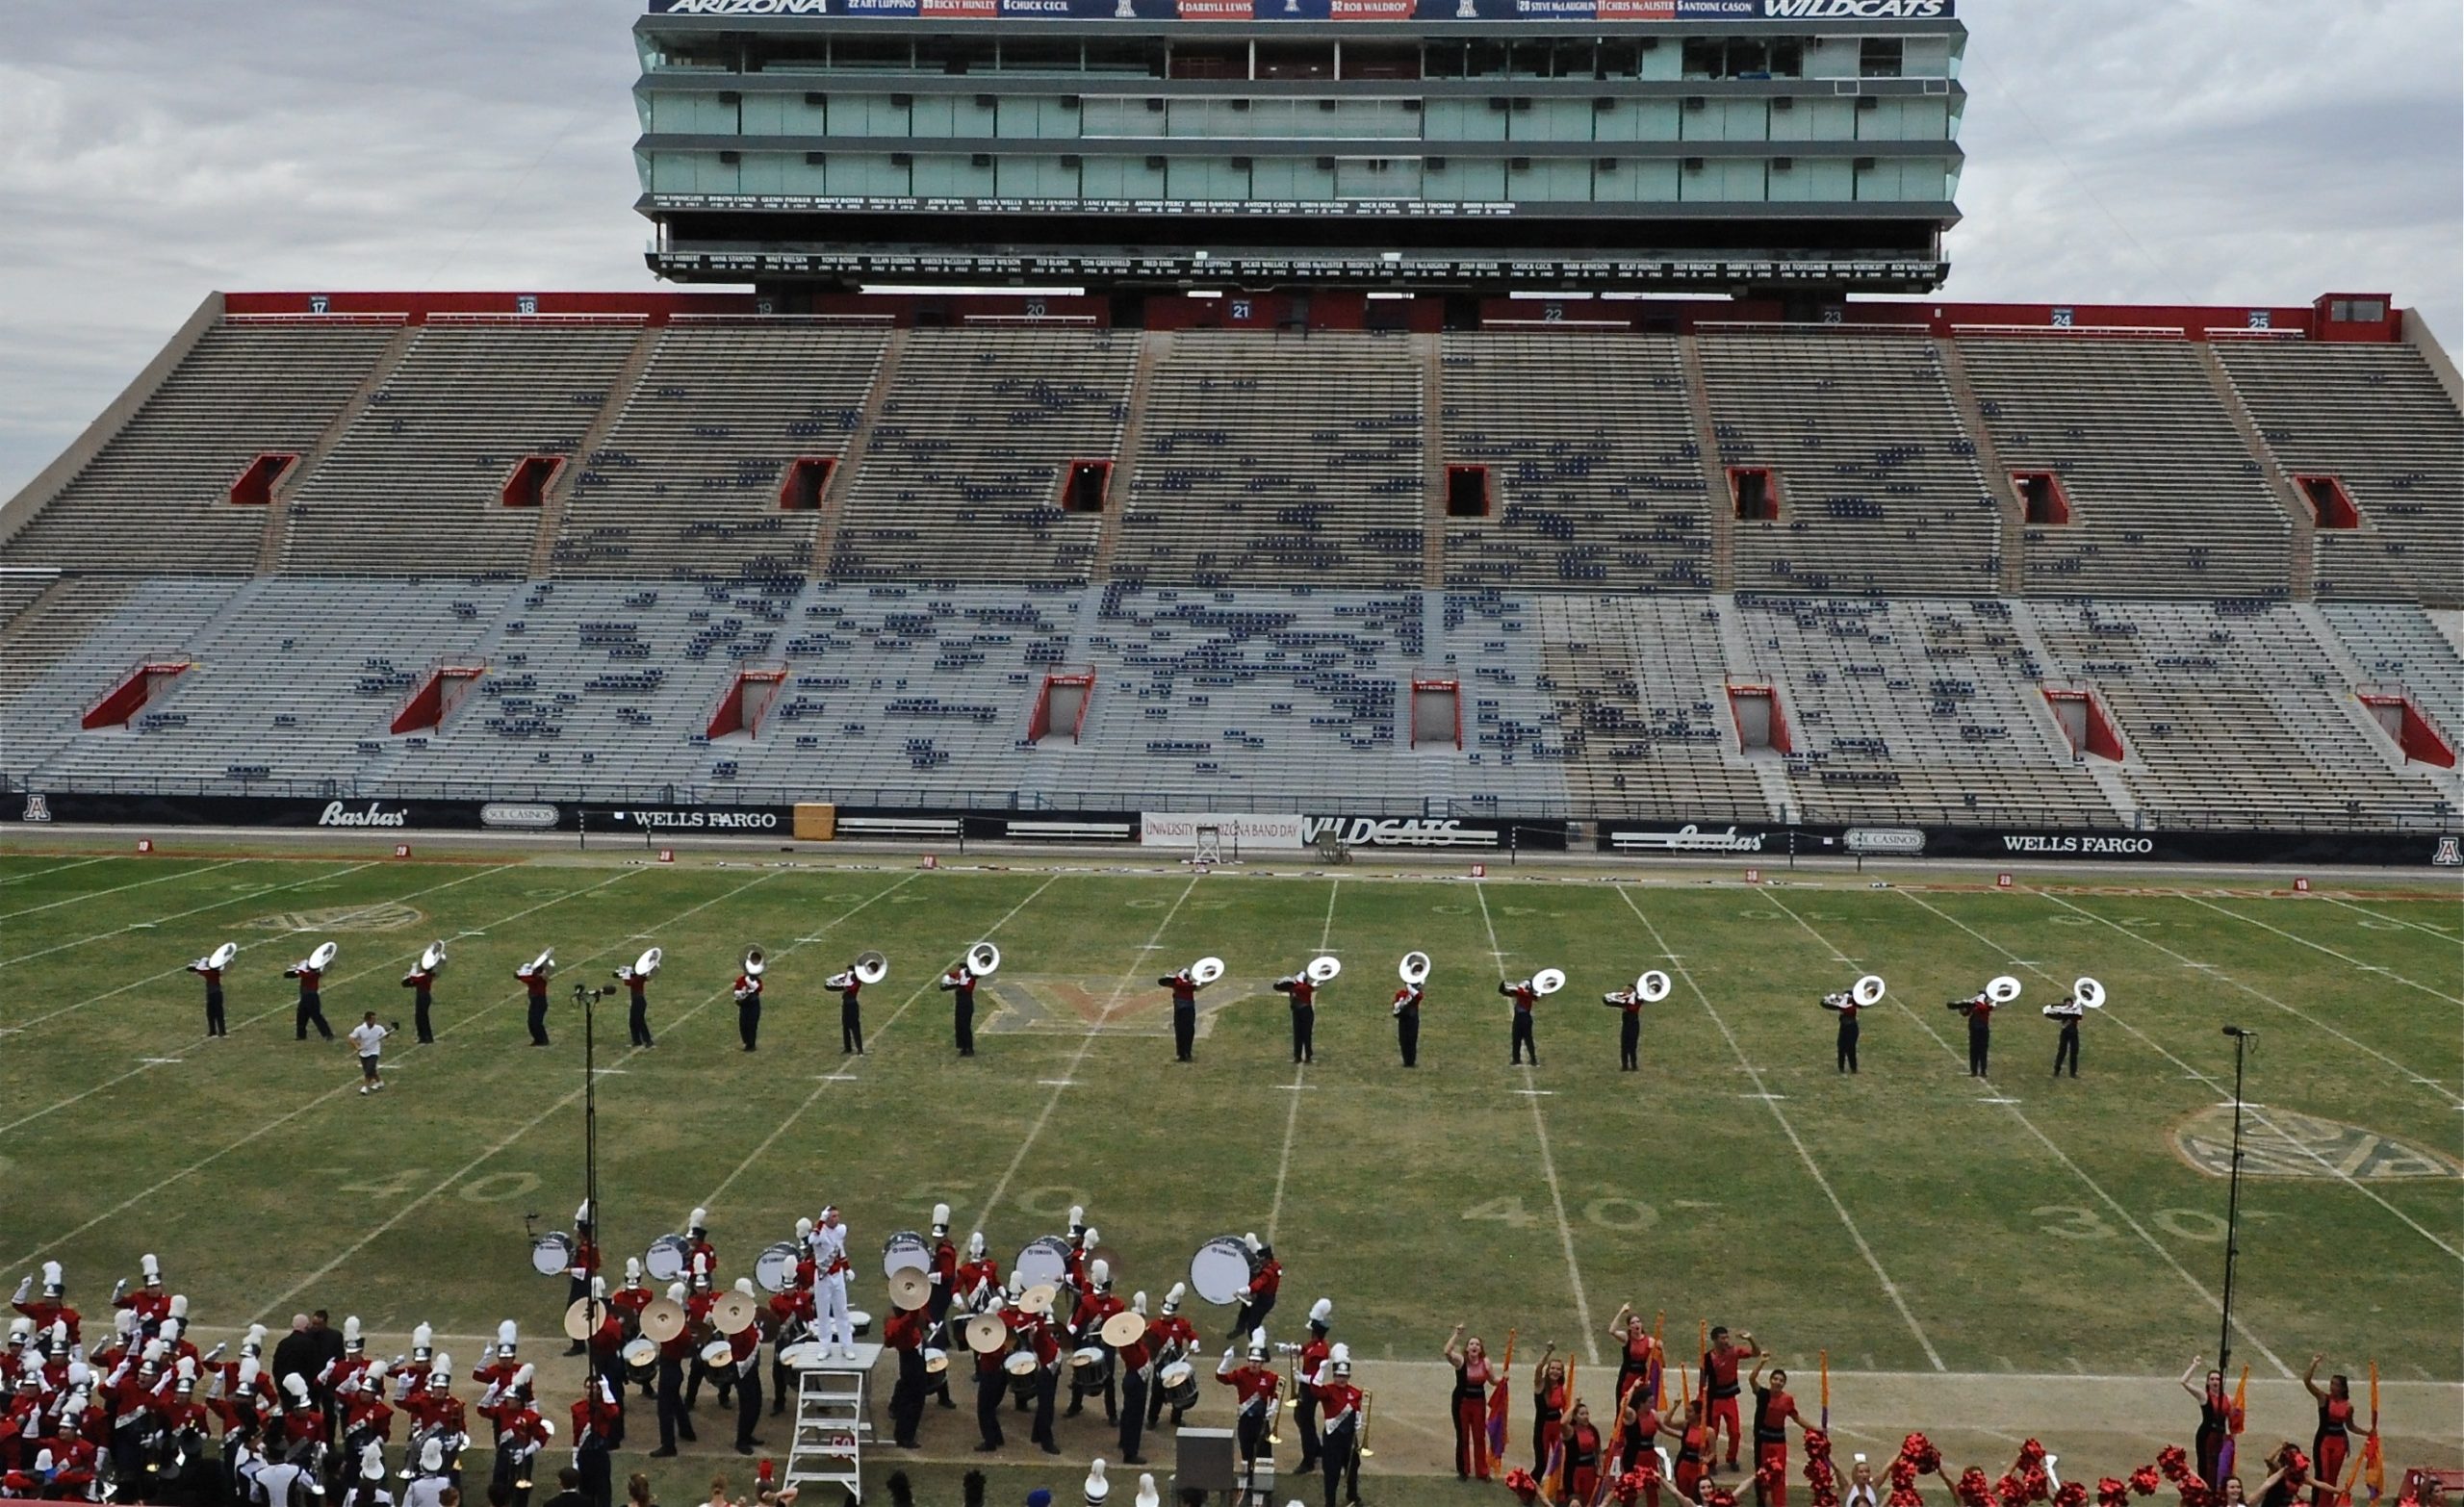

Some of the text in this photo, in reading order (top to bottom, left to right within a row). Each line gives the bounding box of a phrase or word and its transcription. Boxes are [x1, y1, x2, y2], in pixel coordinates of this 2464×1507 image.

[667, 0, 828, 13] ARIZONA
[934, 0, 961, 9] RICKY
[962, 0, 995, 9] HUNLEY
[1003, 0, 1068, 11] 6 CHUCK CECIL
[1177, 1, 1252, 12] 4 DARRYLL LEWIS
[1330, 1, 1406, 12] 92 ROB WALDROP
[1531, 2, 1551, 12] STEVE
[1552, 1, 1596, 11] McLAUGHLIN
[1606, 2, 1630, 11] CHRIS
[1631, 2, 1674, 11] McALISTER
[1677, 0, 1751, 12] 5 ANTOINE CASON
[1764, 0, 1941, 16] WILDCATS
[312, 302, 325, 314] 17
[519, 301, 534, 314] 18
[1027, 304, 1044, 317] 20
[1233, 305, 1247, 318] 21
[1546, 309, 1562, 320] 22
[2052, 315, 2070, 326] 24
[2249, 319, 2268, 329] 25
[23, 794, 51, 821] A
[319, 801, 408, 826] Bashas'
[488, 808, 552, 819] SOL CASINOS
[633, 811, 777, 828] WELLS FARGO
[1146, 822, 1194, 836] UNIVERSITY
[1251, 825, 1278, 838] BAND
[1280, 825, 1298, 838] DAY
[1875, 835, 1919, 845] CASINOS
[2003, 836, 2153, 853] WELLS FARGO
